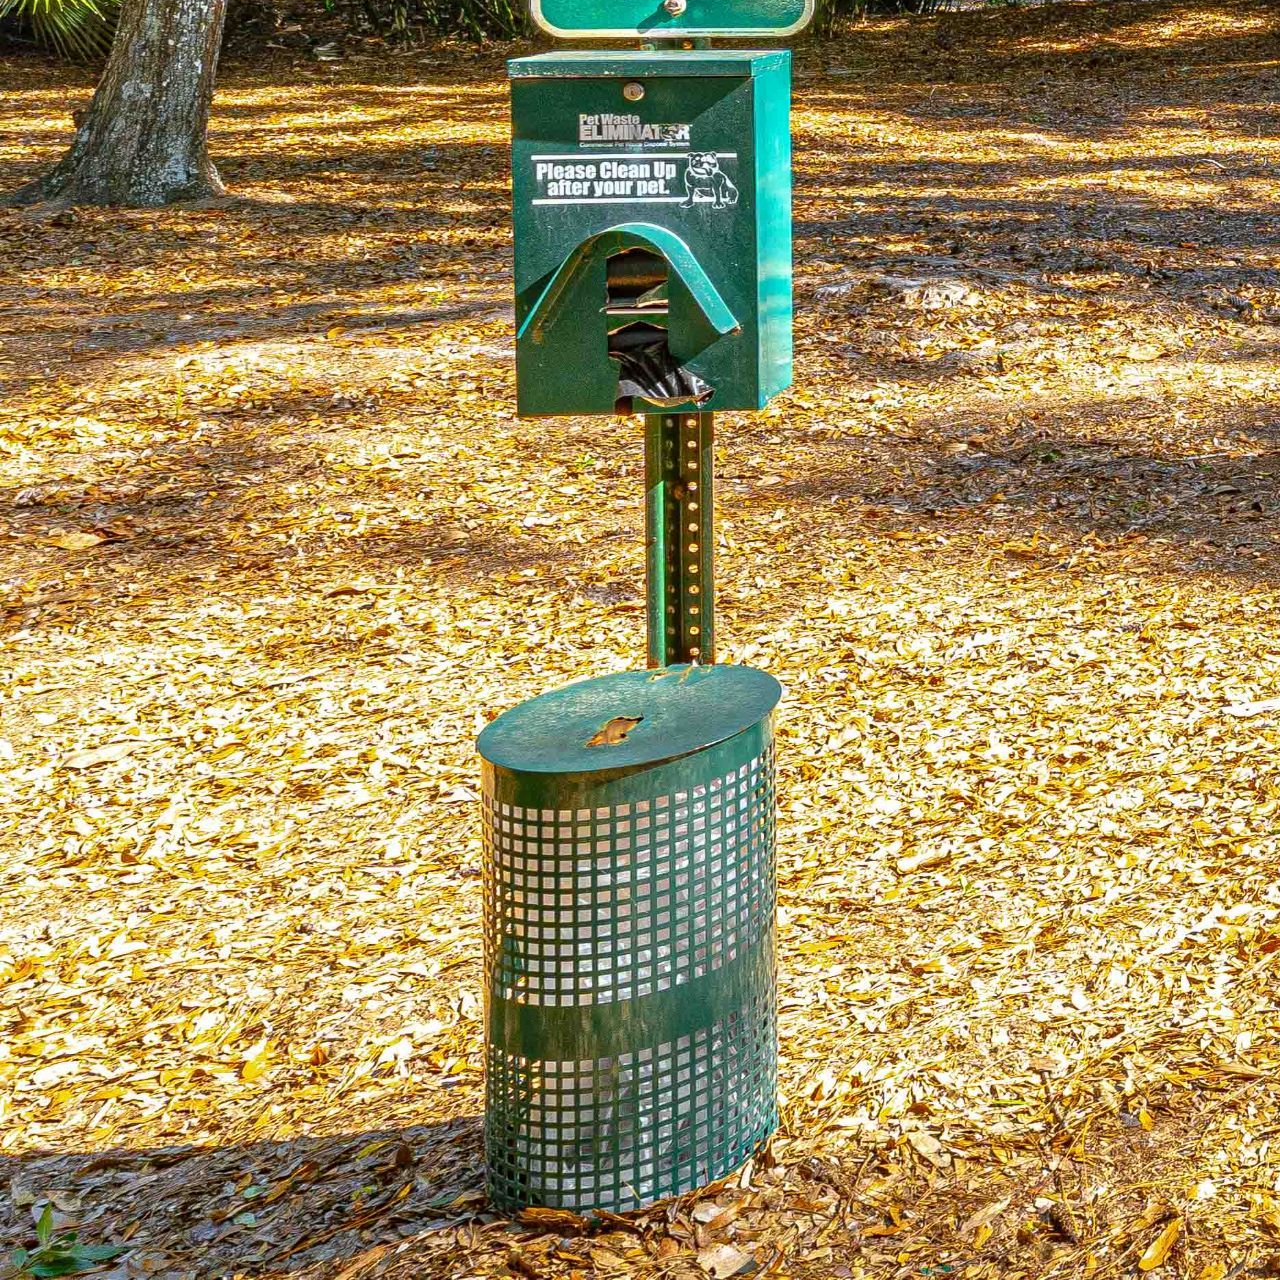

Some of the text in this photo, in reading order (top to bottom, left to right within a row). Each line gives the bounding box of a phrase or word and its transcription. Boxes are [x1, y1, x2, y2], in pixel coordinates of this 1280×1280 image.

[579, 114, 640, 125] Pet Waste
[536, 161, 676, 180] Please Clean Up
[547, 179, 670, 197] after your pet.
